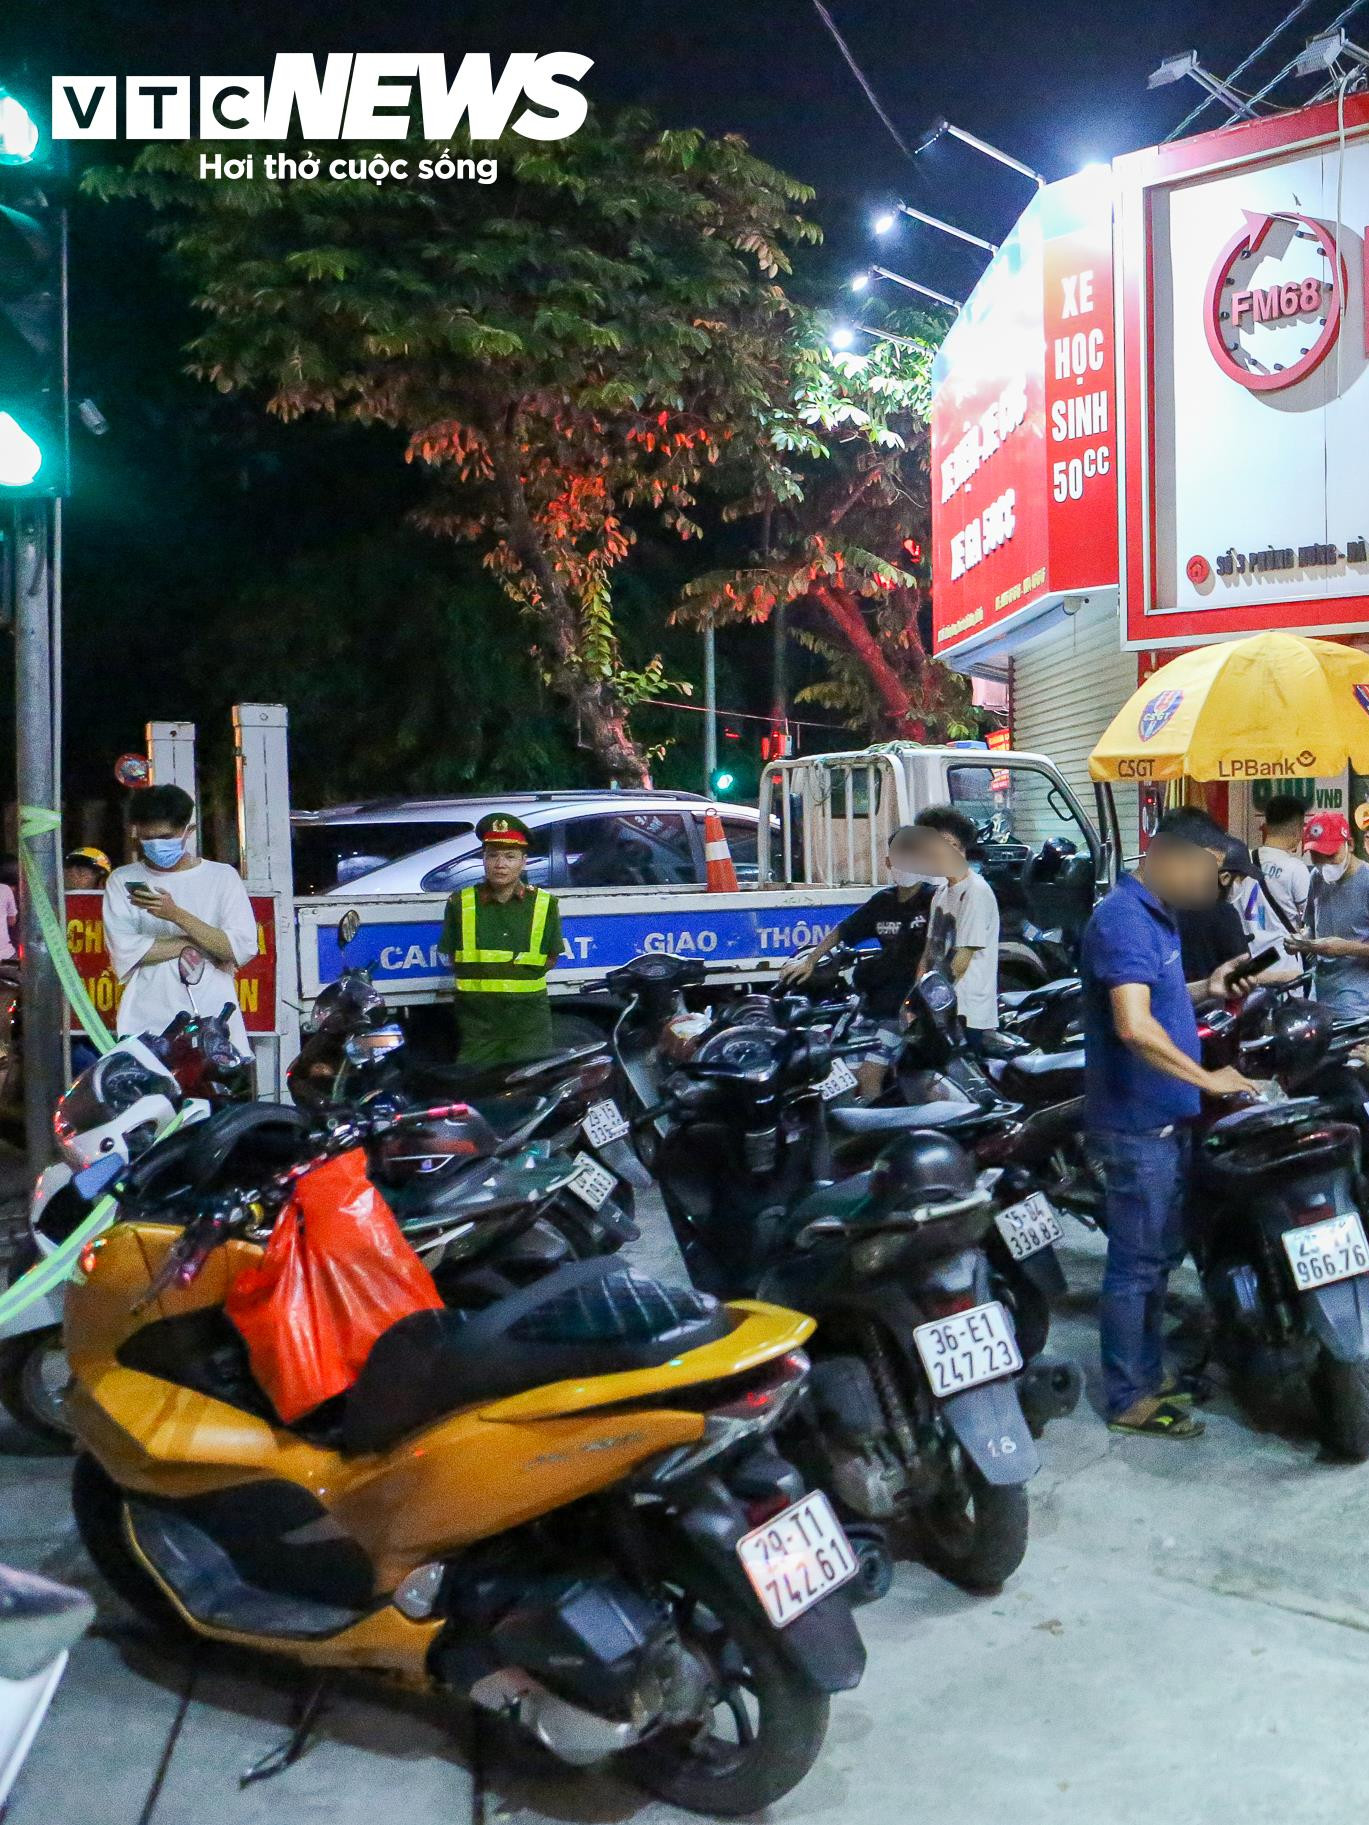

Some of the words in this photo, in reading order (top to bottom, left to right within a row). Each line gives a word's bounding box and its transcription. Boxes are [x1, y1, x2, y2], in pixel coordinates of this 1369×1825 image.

[1061, 270, 1094, 319] XE
[1231, 278, 1322, 326] FM68
[1054, 328, 1104, 385] HỌC
[1052, 390, 1108, 442] SINH
[1117, 759, 1155, 778] CSGT
[1219, 758, 1298, 778] LPBank
[644, 930, 718, 953] GIAO
[756, 920, 836, 950] THÔN
[1297, 1244, 1366, 1283] 966.76
[930, 1313, 994, 1355] 36-E1
[934, 1341, 1013, 1389] 247.23
[755, 1506, 824, 1568] 29-T1
[765, 1539, 848, 1617] 742.61
